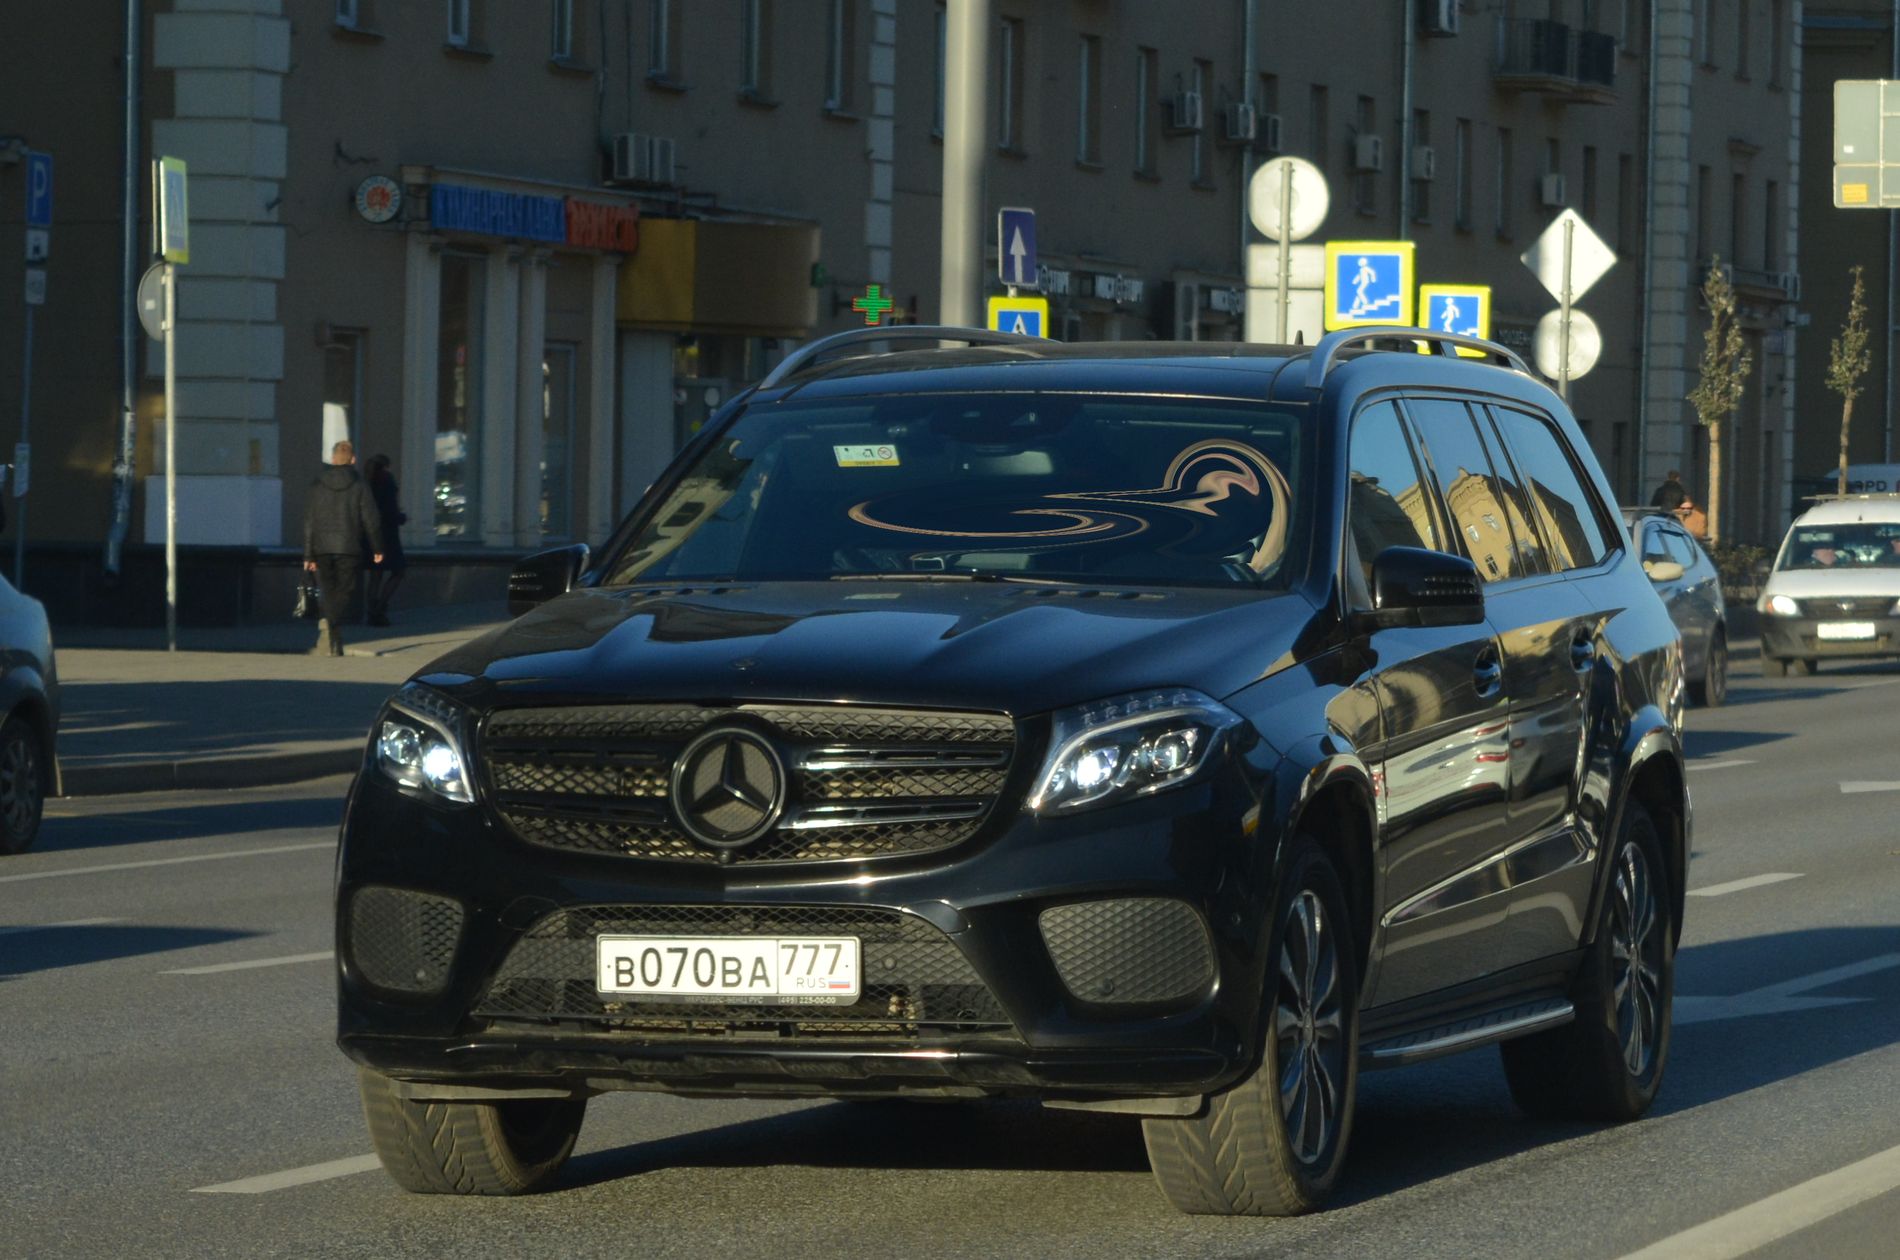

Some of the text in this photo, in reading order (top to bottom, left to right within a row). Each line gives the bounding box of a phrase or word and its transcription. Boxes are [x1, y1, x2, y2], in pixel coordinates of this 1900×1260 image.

[32, 160, 47, 217] P
[615, 944, 843, 988] В070ВА 777
[796, 977, 826, 989] RUS
